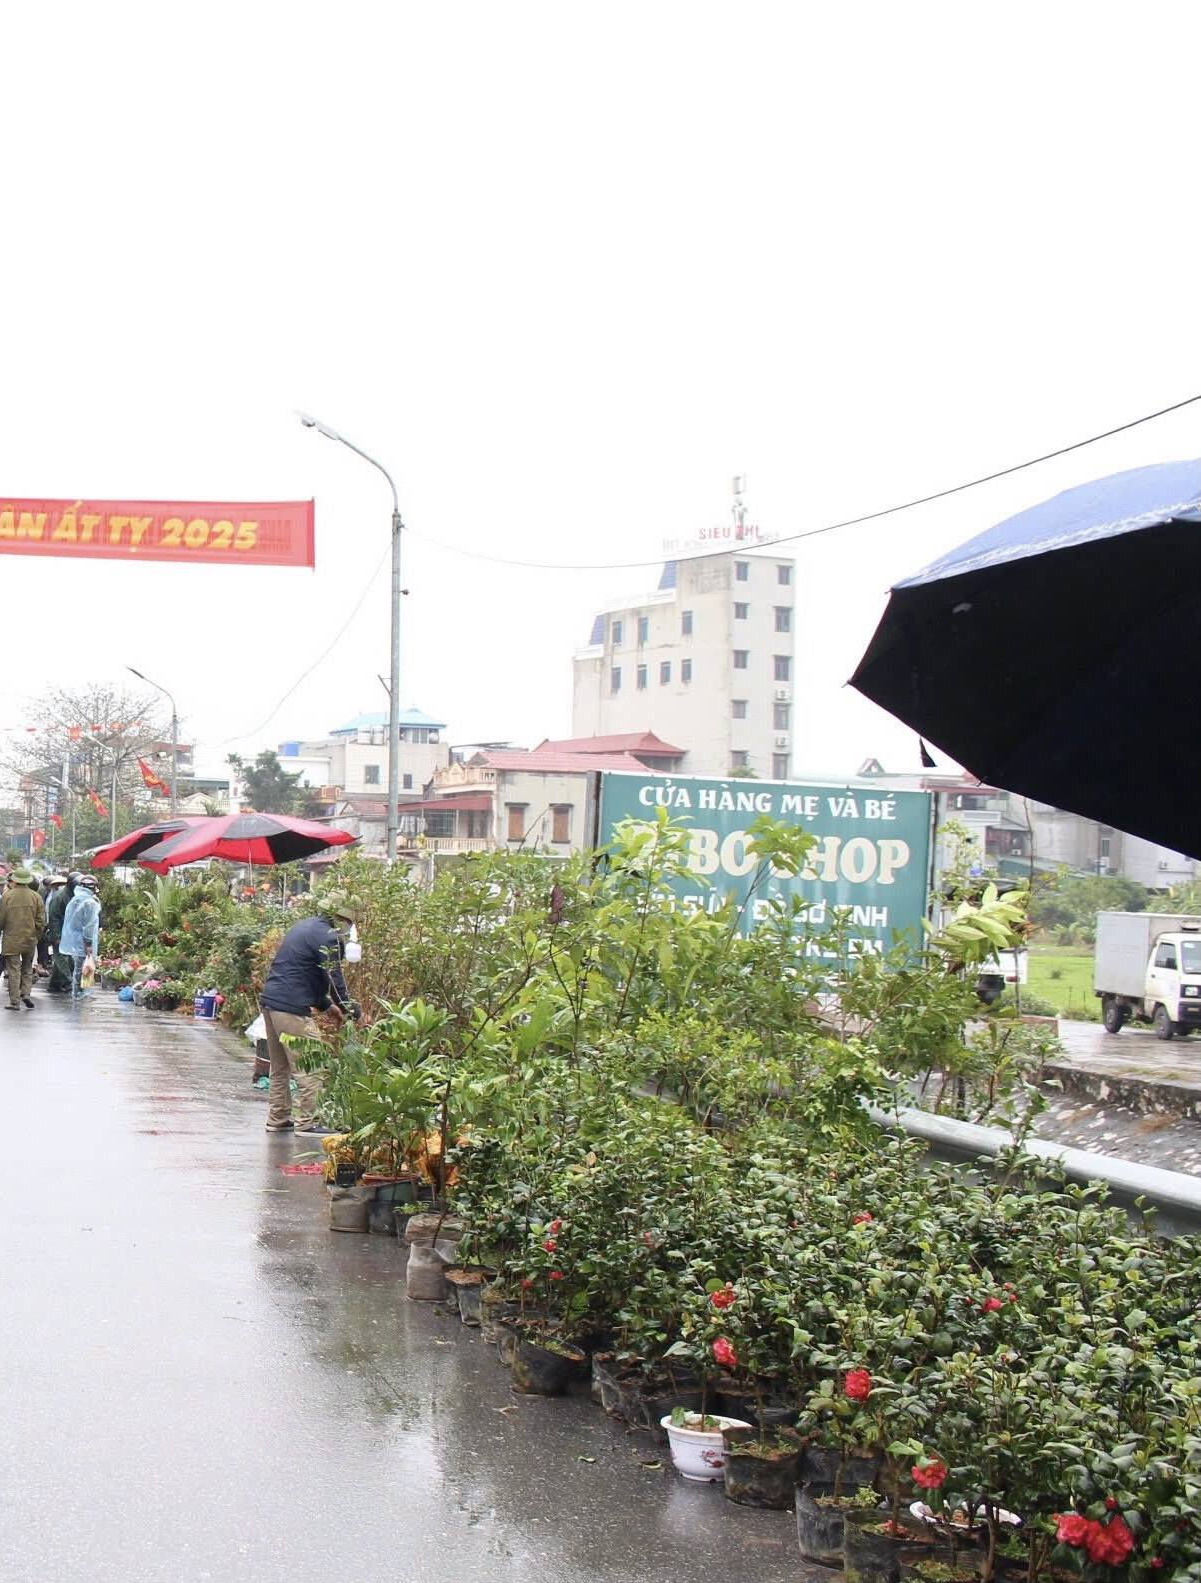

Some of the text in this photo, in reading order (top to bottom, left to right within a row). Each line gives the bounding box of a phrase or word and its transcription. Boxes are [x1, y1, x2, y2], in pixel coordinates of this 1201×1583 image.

[52, 500, 101, 543] ẤT
[108, 516, 154, 552] TỴ
[159, 518, 259, 550] 2025
[639, 779, 896, 822] CỬA HÀNG MẸ VÀ BÉ
